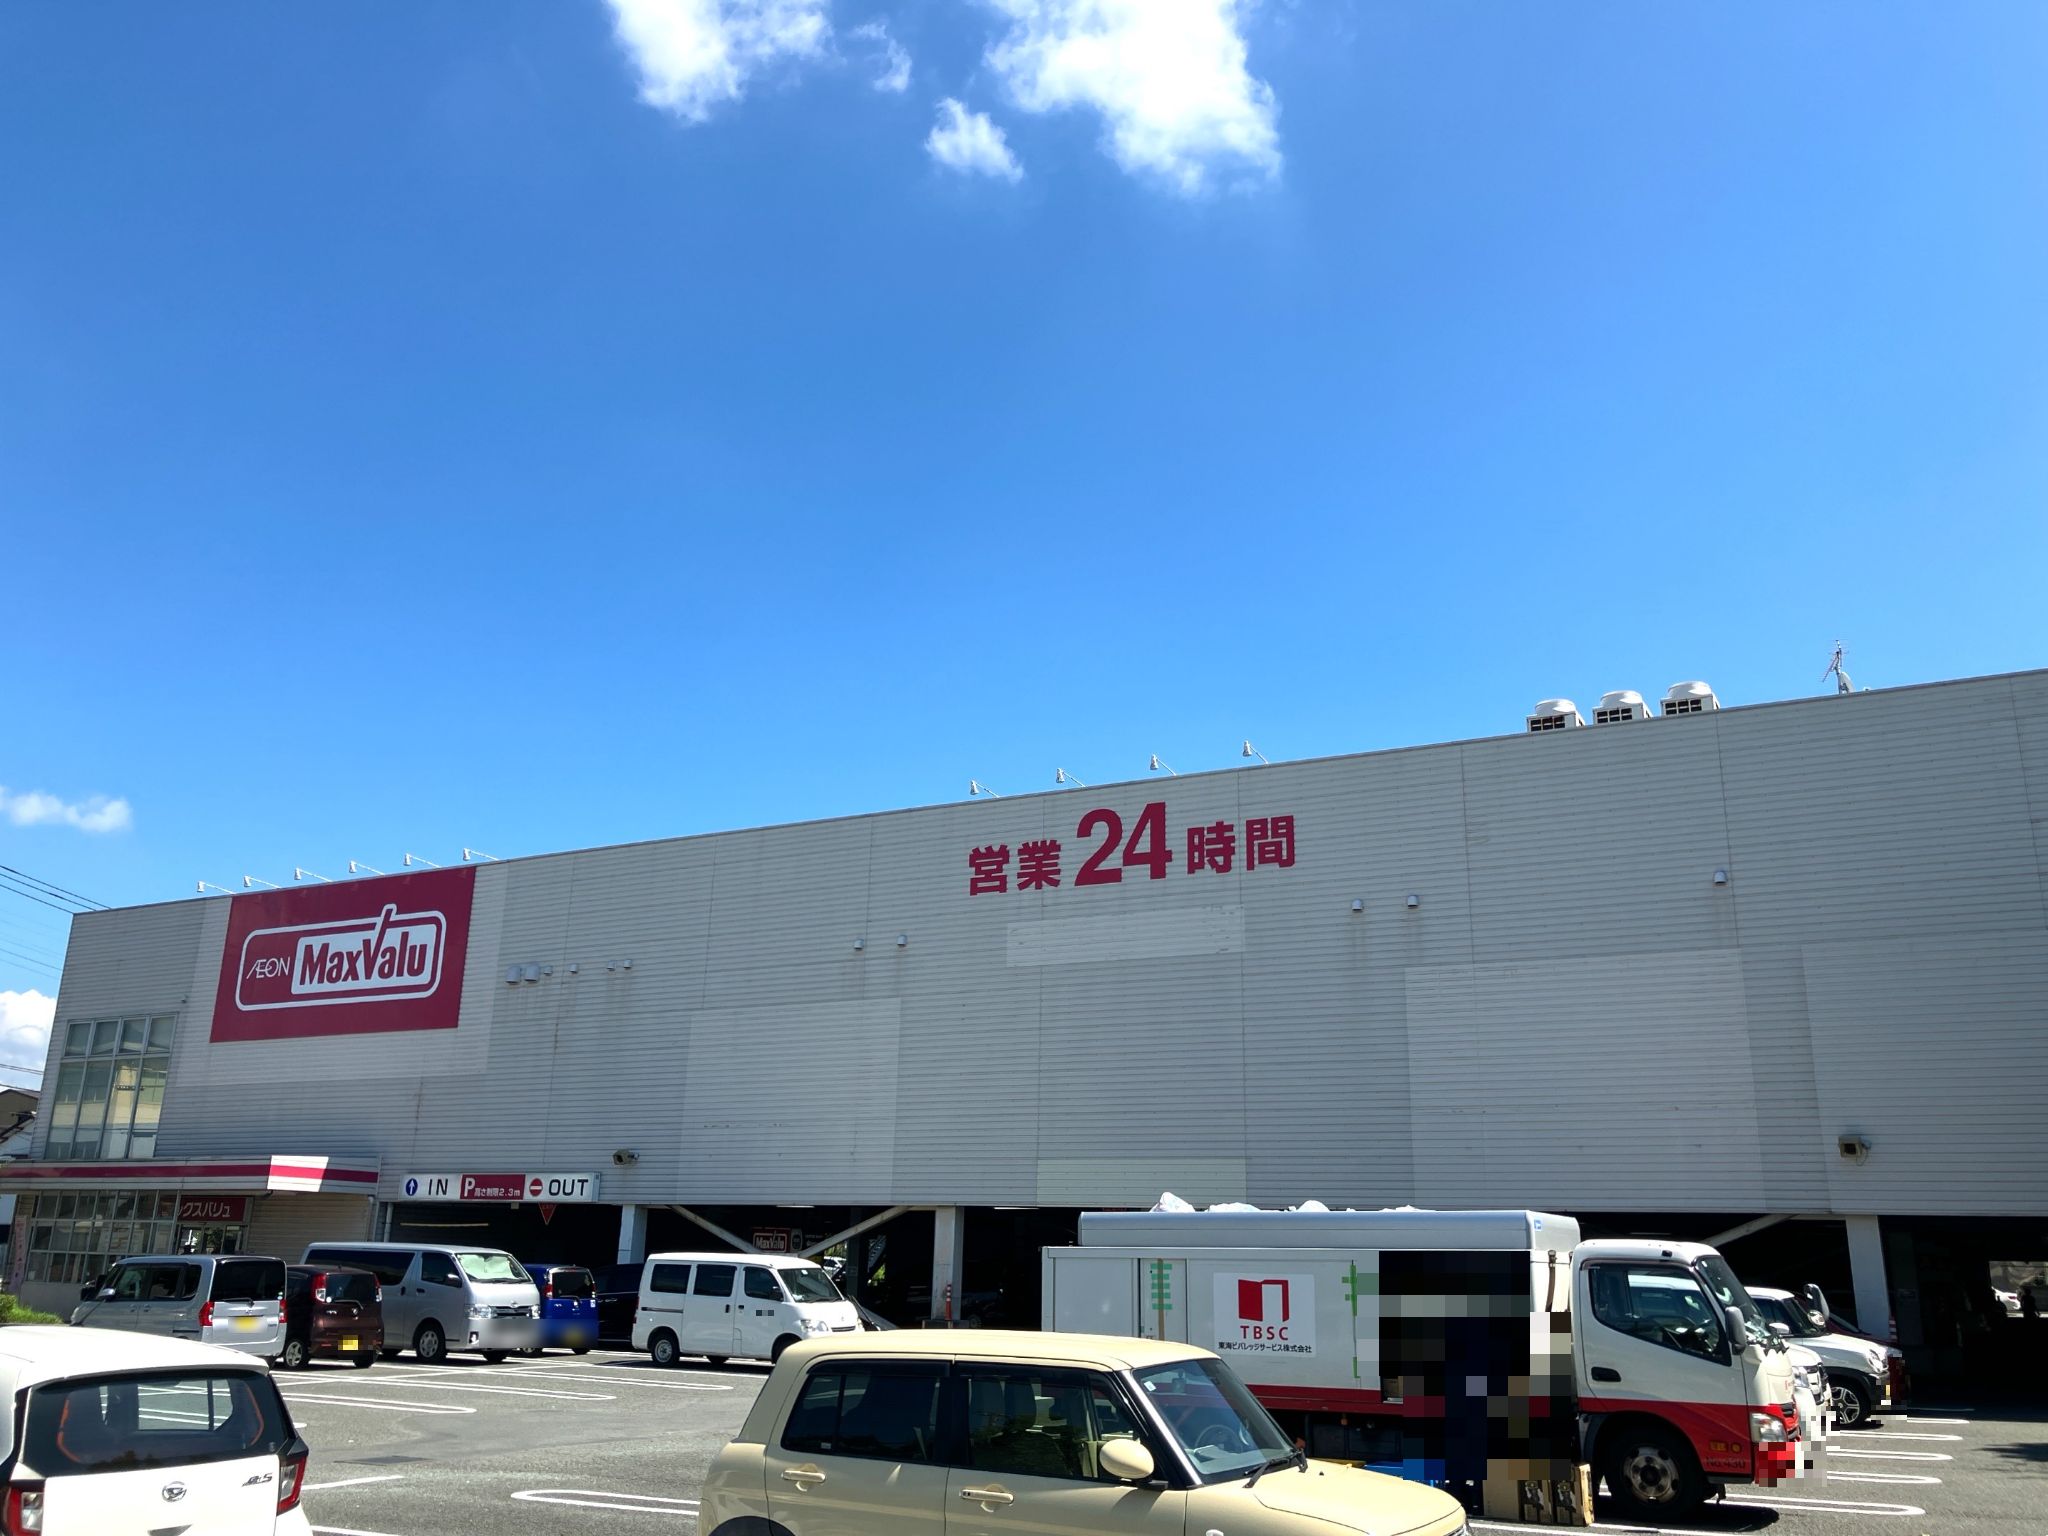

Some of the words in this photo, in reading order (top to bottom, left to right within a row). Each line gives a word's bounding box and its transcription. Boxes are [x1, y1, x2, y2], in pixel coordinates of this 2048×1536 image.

[299, 907, 428, 987] MaxValu
[428, 1177, 449, 1196] IN
[463, 1177, 476, 1198] P
[548, 1178, 589, 1197] OUT
[1240, 1325, 1289, 1341] TBSC
